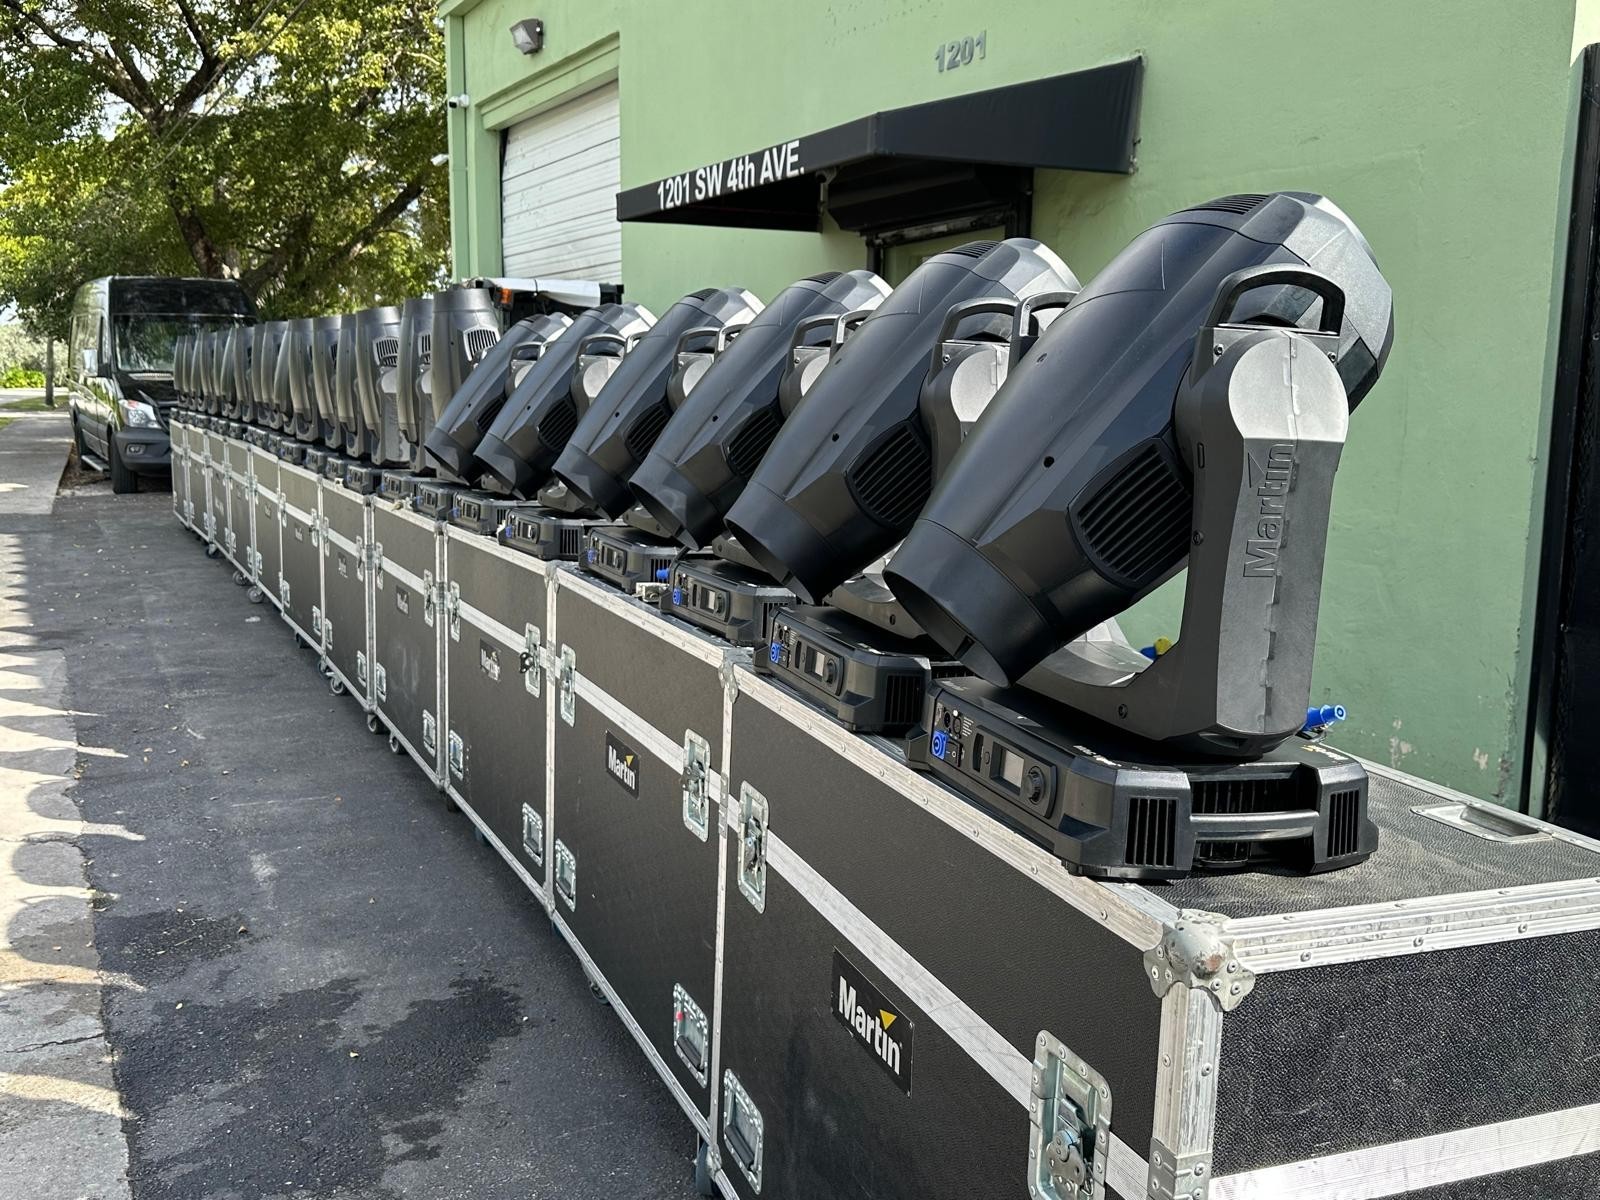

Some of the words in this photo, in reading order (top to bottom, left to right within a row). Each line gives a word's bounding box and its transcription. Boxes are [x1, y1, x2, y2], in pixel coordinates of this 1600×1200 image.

[935, 29, 987, 73] 1201
[657, 172, 690, 210] 1201
[694, 162, 724, 201] SW
[727, 155, 756, 192] 4th
[759, 139, 805, 185] AVE.
[1243, 443, 1294, 577] Martin
[608, 744, 635, 790] Martin
[838, 975, 901, 1076] Martin
